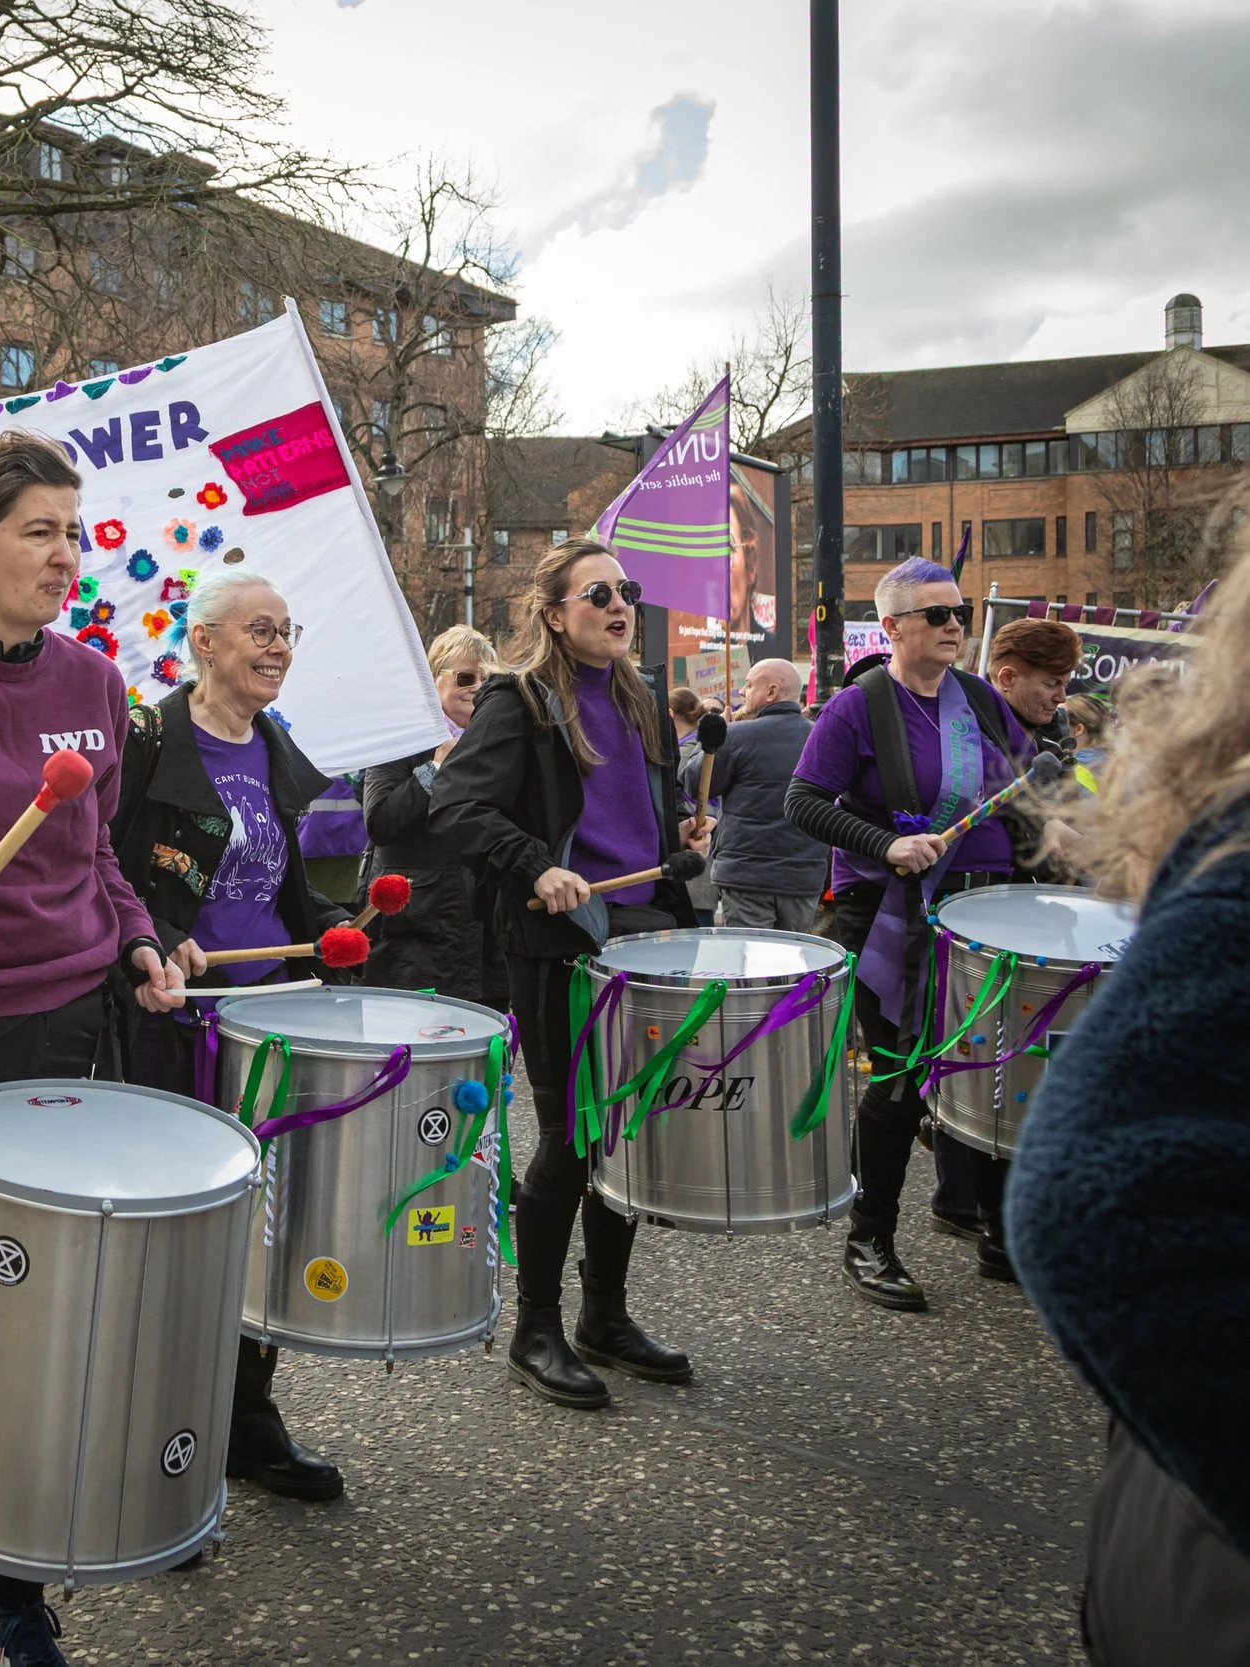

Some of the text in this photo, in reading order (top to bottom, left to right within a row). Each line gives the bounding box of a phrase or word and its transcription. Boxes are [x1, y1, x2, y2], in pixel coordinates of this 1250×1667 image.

[62, 401, 209, 470] WER
[220, 428, 286, 462] MAKE
[230, 428, 334, 480] PATTERNS
[240, 468, 281, 491] NOT
[39, 729, 105, 753] IWD
[215, 774, 242, 785] CAN'T
[243, 774, 261, 788] BURN
